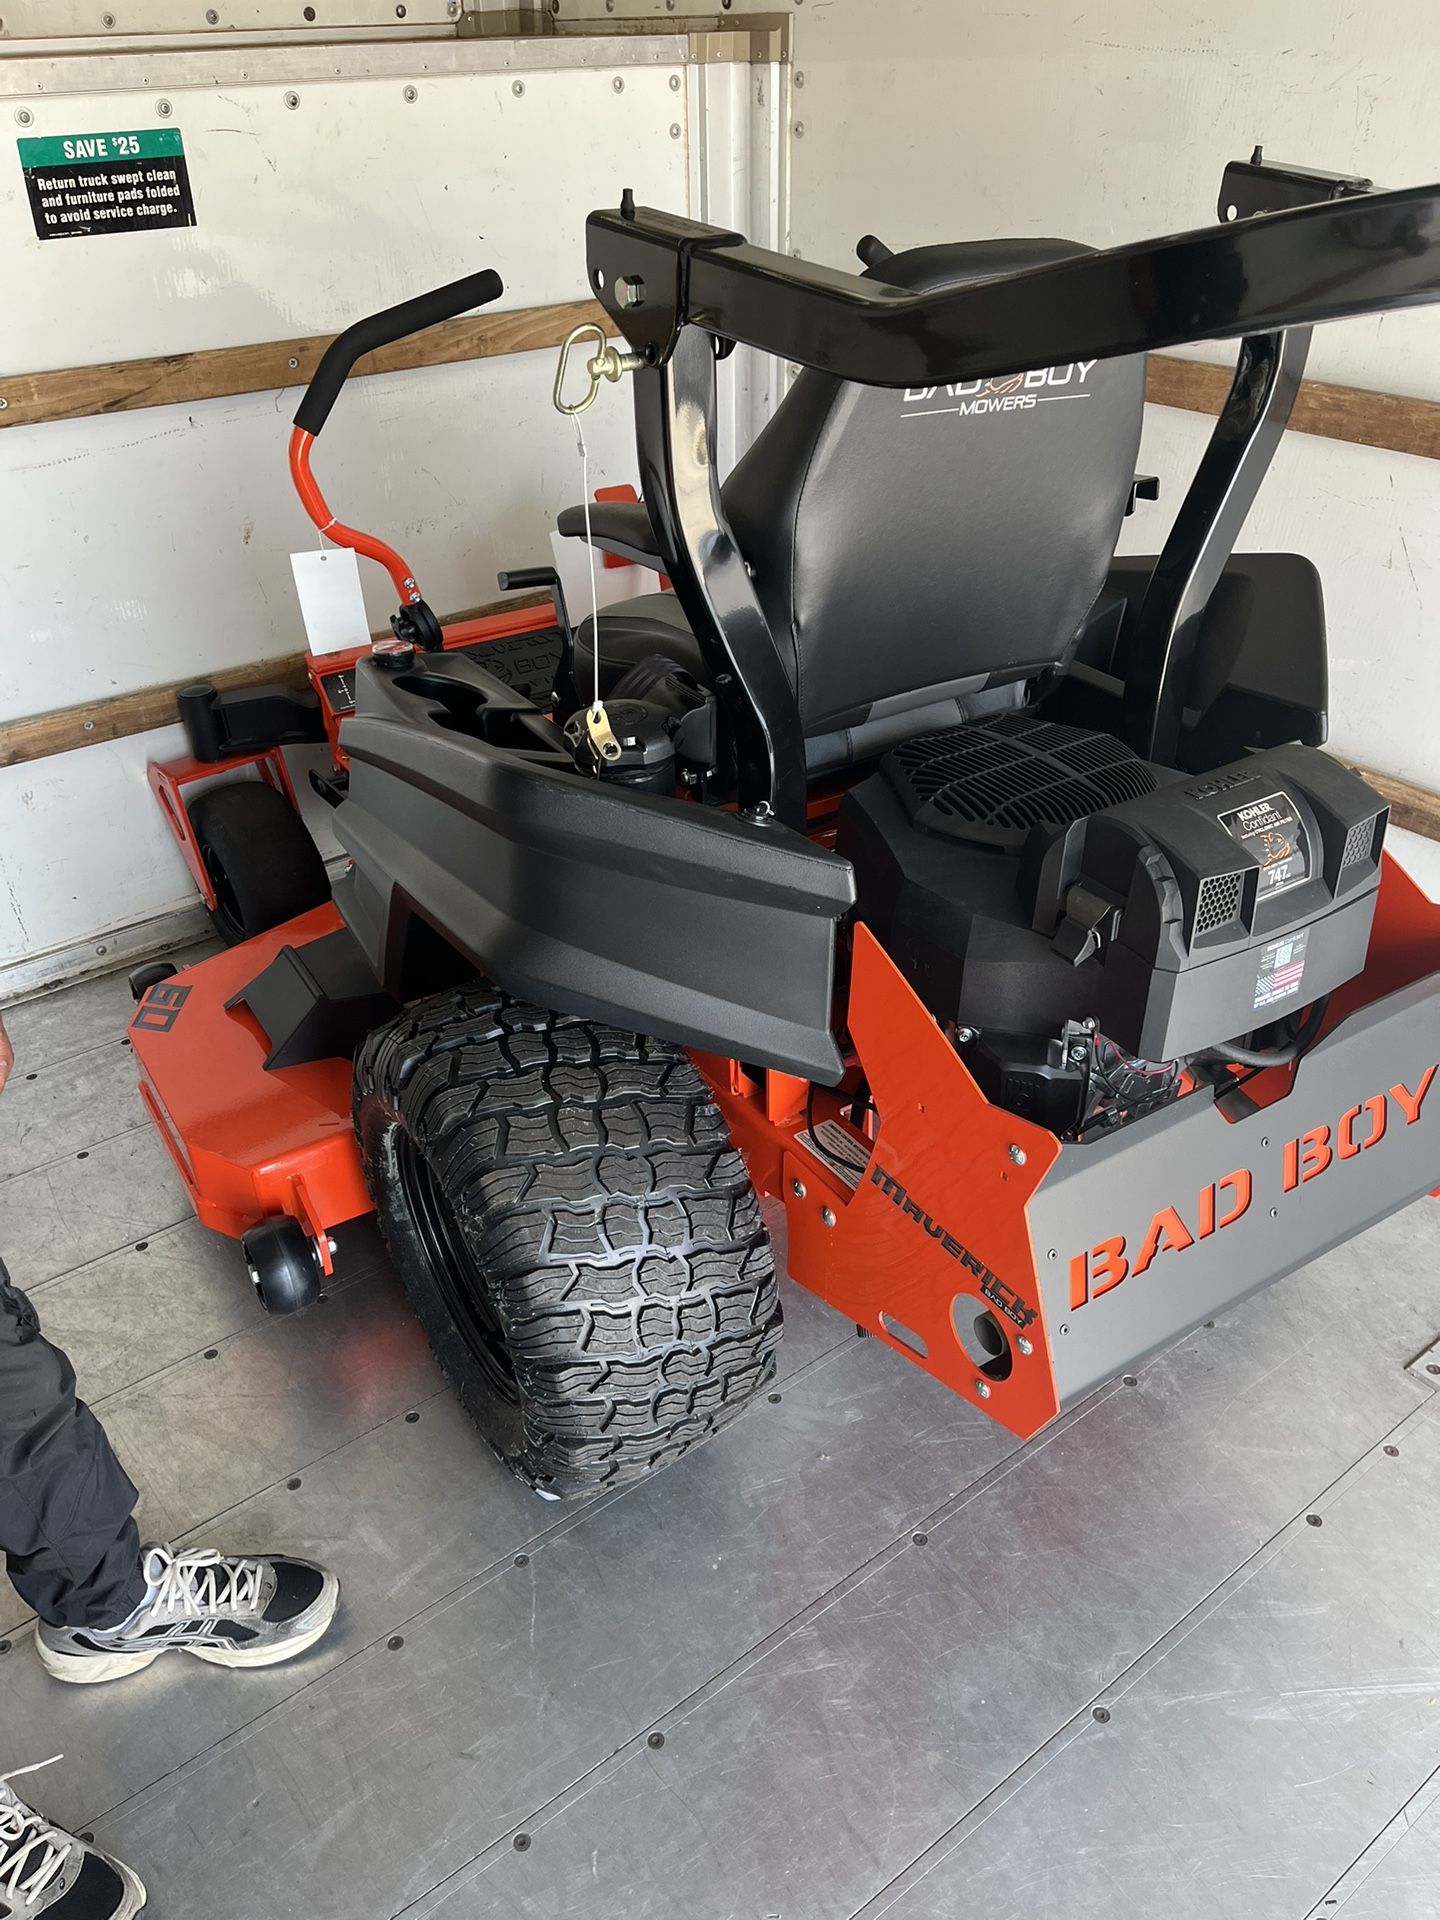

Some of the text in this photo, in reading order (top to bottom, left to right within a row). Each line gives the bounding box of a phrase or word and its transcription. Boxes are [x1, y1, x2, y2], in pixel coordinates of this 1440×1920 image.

[63, 136, 140, 159] SAVE $25
[37, 169, 176, 191] Return truck swept clean
[41, 184, 180, 208] and furniture pads folded
[44, 202, 178, 224] to avoid service charge.
[959, 394, 1037, 416] MOWERS
[1243, 810, 1283, 831] Confidant
[131, 984, 193, 1032] 60
[1069, 1063, 1439, 1312] BAD BOY
[870, 1163, 1039, 1327] MAVERICK
[984, 1288, 1024, 1326] BAD BOY
